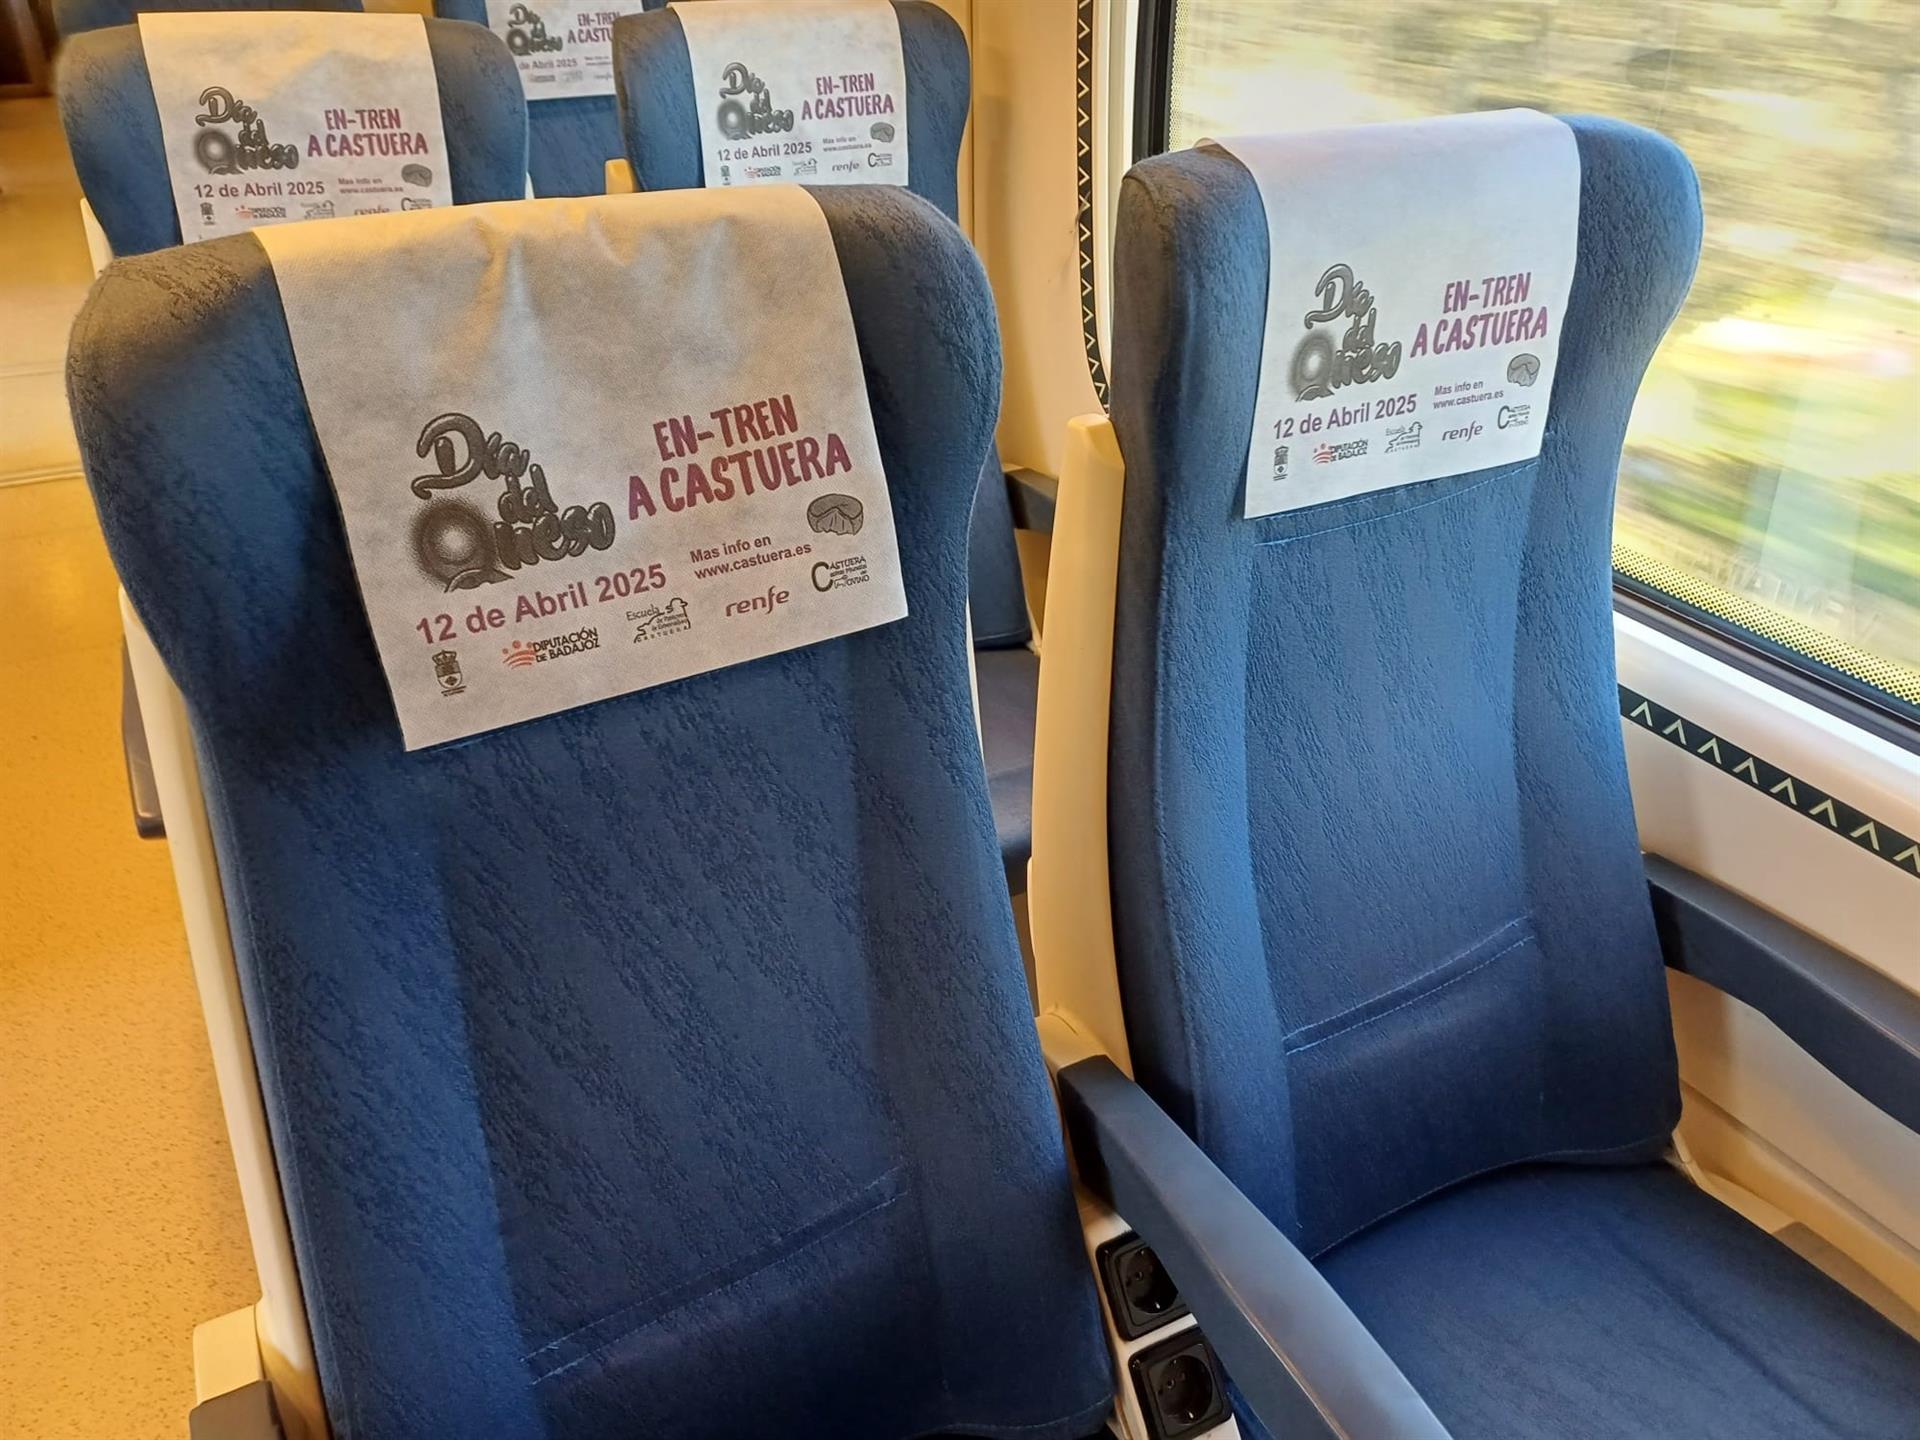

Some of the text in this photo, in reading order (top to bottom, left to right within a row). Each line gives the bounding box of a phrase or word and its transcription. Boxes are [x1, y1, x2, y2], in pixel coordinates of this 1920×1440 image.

[567, 29, 577, 43] A
[816, 73, 875, 95] EN-TREN
[324, 108, 402, 130] EN-TREN
[802, 94, 895, 120] A CASTUERA
[307, 132, 429, 157] A CASTUERA
[718, 141, 813, 161] 12 de Abril 2025
[194, 181, 325, 198] 12 de Abril 2025
[1443, 272, 1531, 314] EN-TREN
[1410, 306, 1548, 358] A CASTUERA
[1433, 390, 1504, 410] www.castuera.es
[1434, 380, 1484, 396] Mas info en
[653, 394, 799, 462] EN-TREN
[1273, 393, 1418, 440] 12 de Abril 2025
[1442, 420, 1483, 442] renfe
[628, 433, 853, 521] A CASTUERA
[690, 535, 772, 564] Mas info en
[694, 543, 812, 580] www.castuera.es
[416, 563, 667, 645] 12 de Abril 2025
[725, 585, 790, 618] renfe
[533, 626, 598, 653] DIPUTACIÓN
[536, 637, 600, 663] DE BADAJOZ
